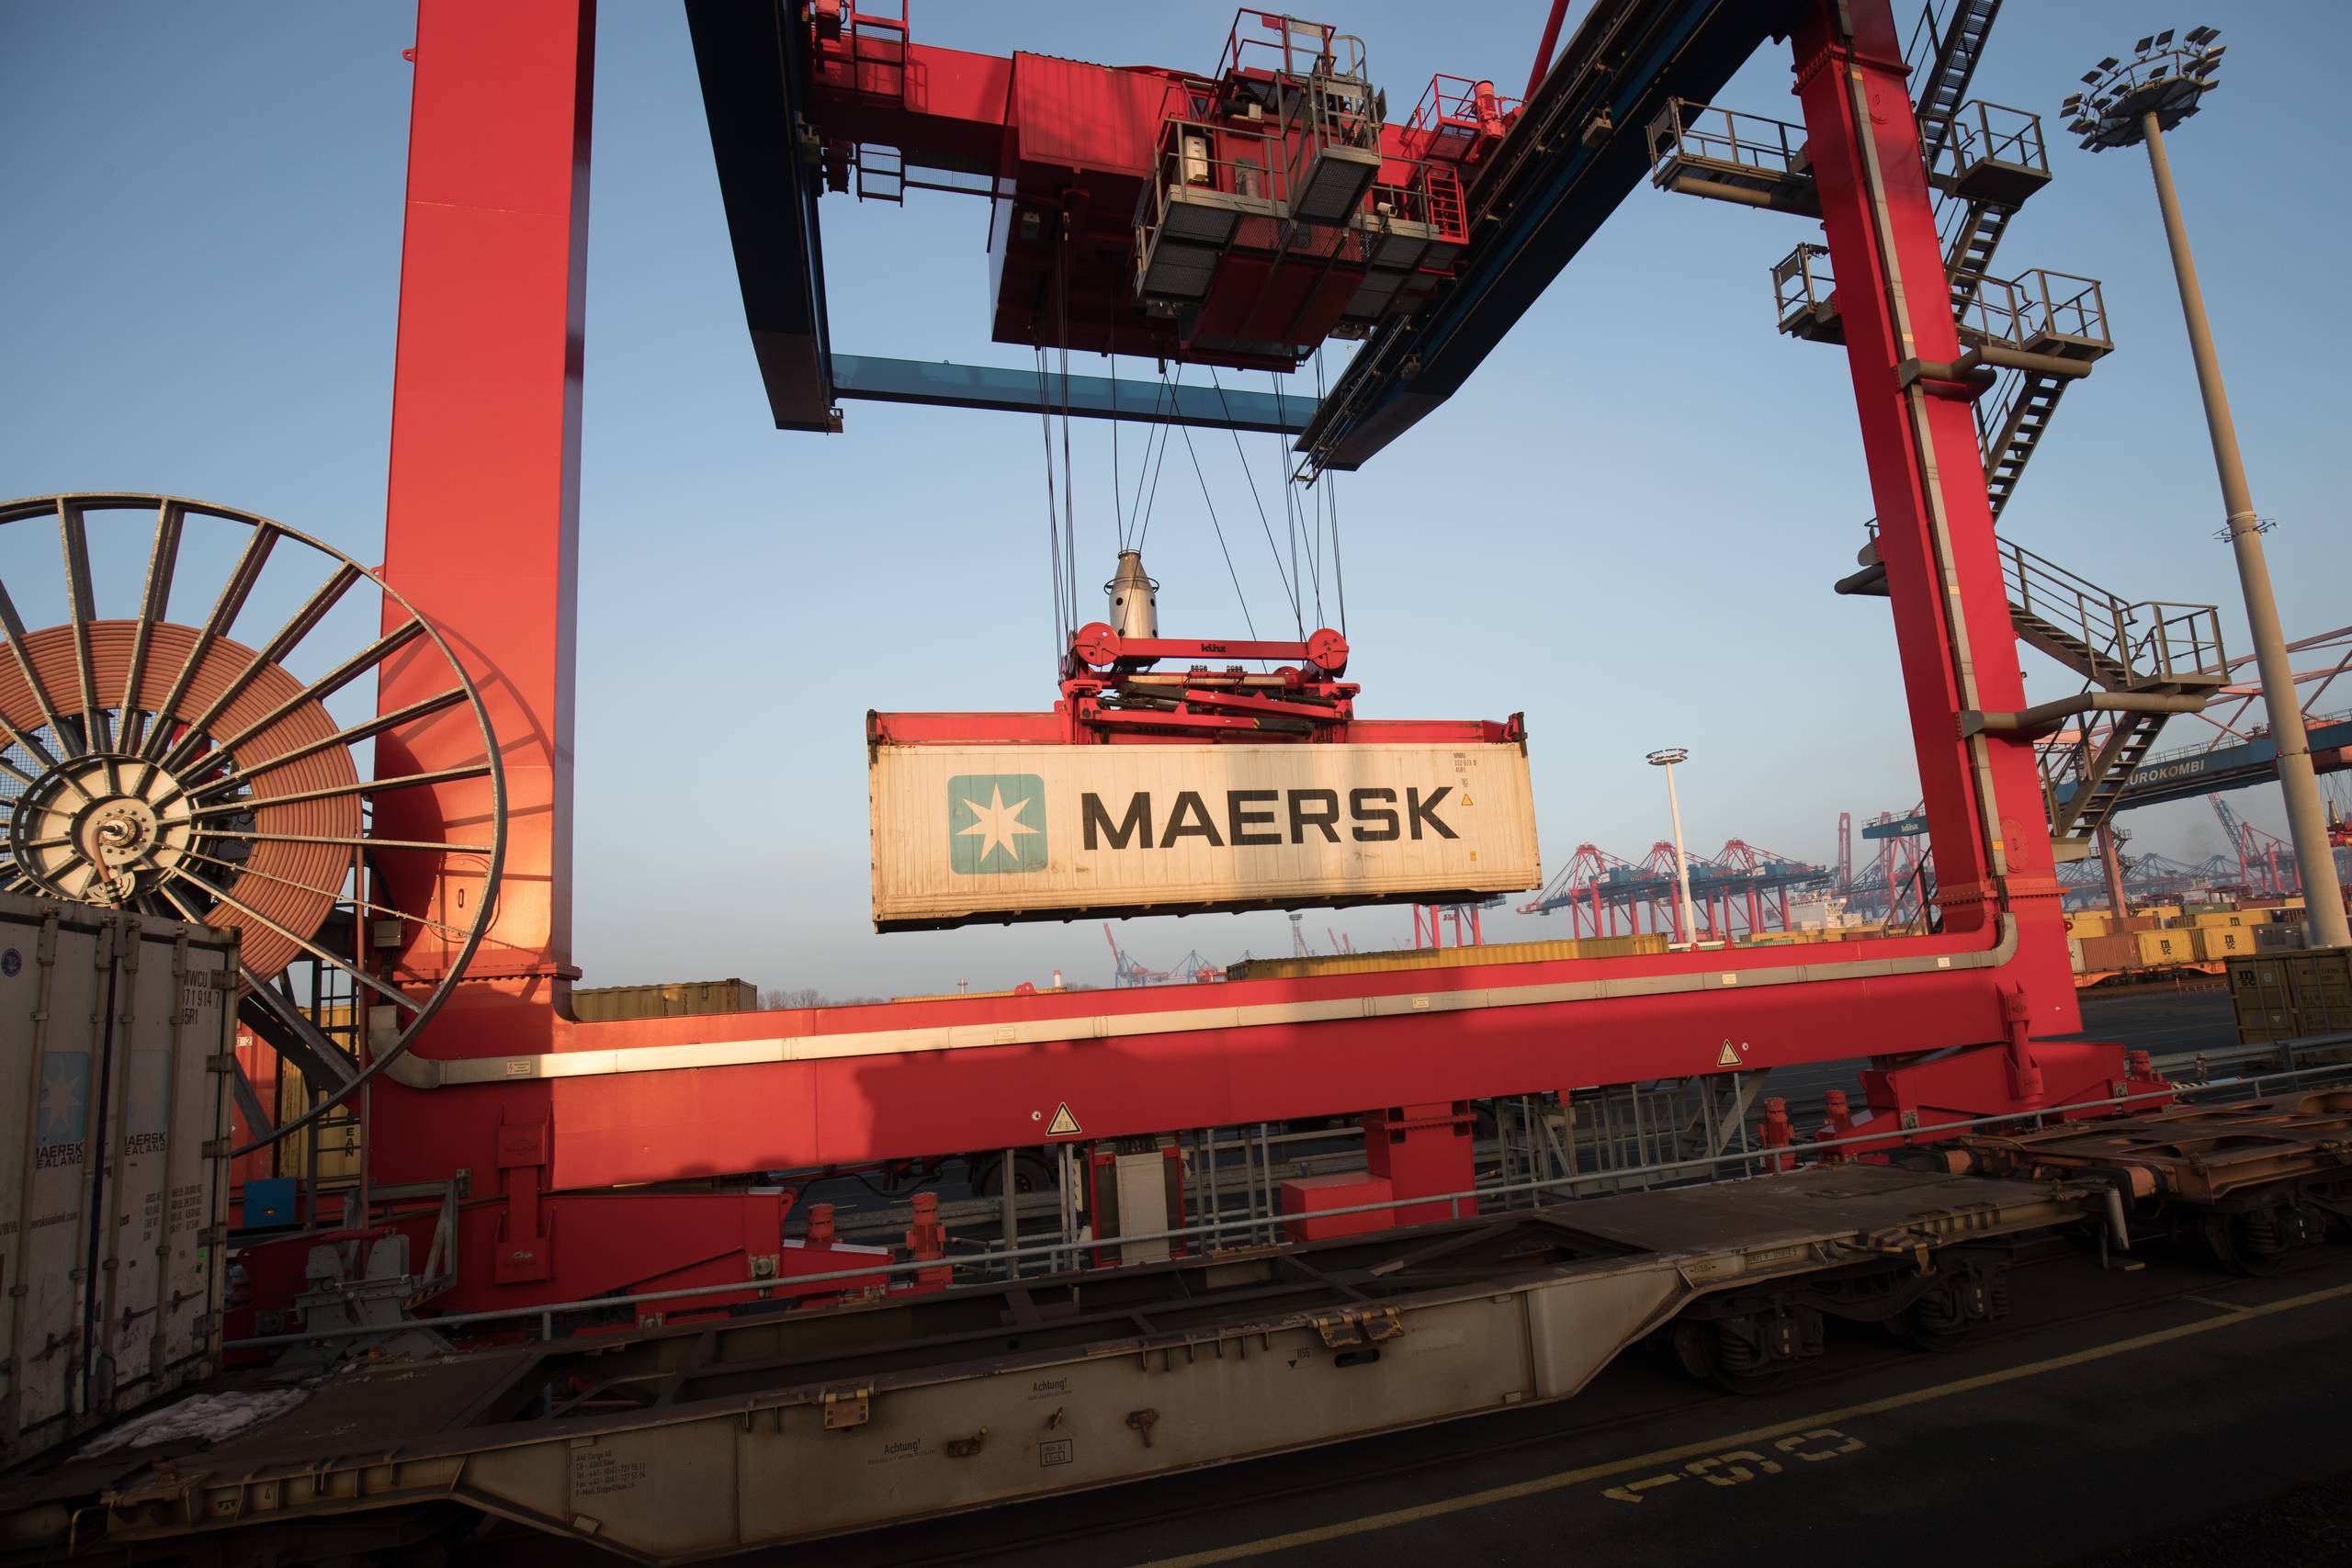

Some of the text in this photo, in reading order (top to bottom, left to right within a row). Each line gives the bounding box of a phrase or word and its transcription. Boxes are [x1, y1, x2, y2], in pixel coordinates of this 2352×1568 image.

[2124, 759, 2205, 787] UROKOMBI
[1080, 786, 1460, 851] MAERSK
[183, 1008, 198, 1026] 5R1
[125, 1131, 166, 1147] AERSK
[37, 1142, 84, 1159] AERSK
[125, 1143, 166, 1156] EALAND
[37, 1155, 84, 1169] EALAND
[1033, 1377, 1068, 1392] Achtung!
[883, 1438, 921, 1455] Achtung!
